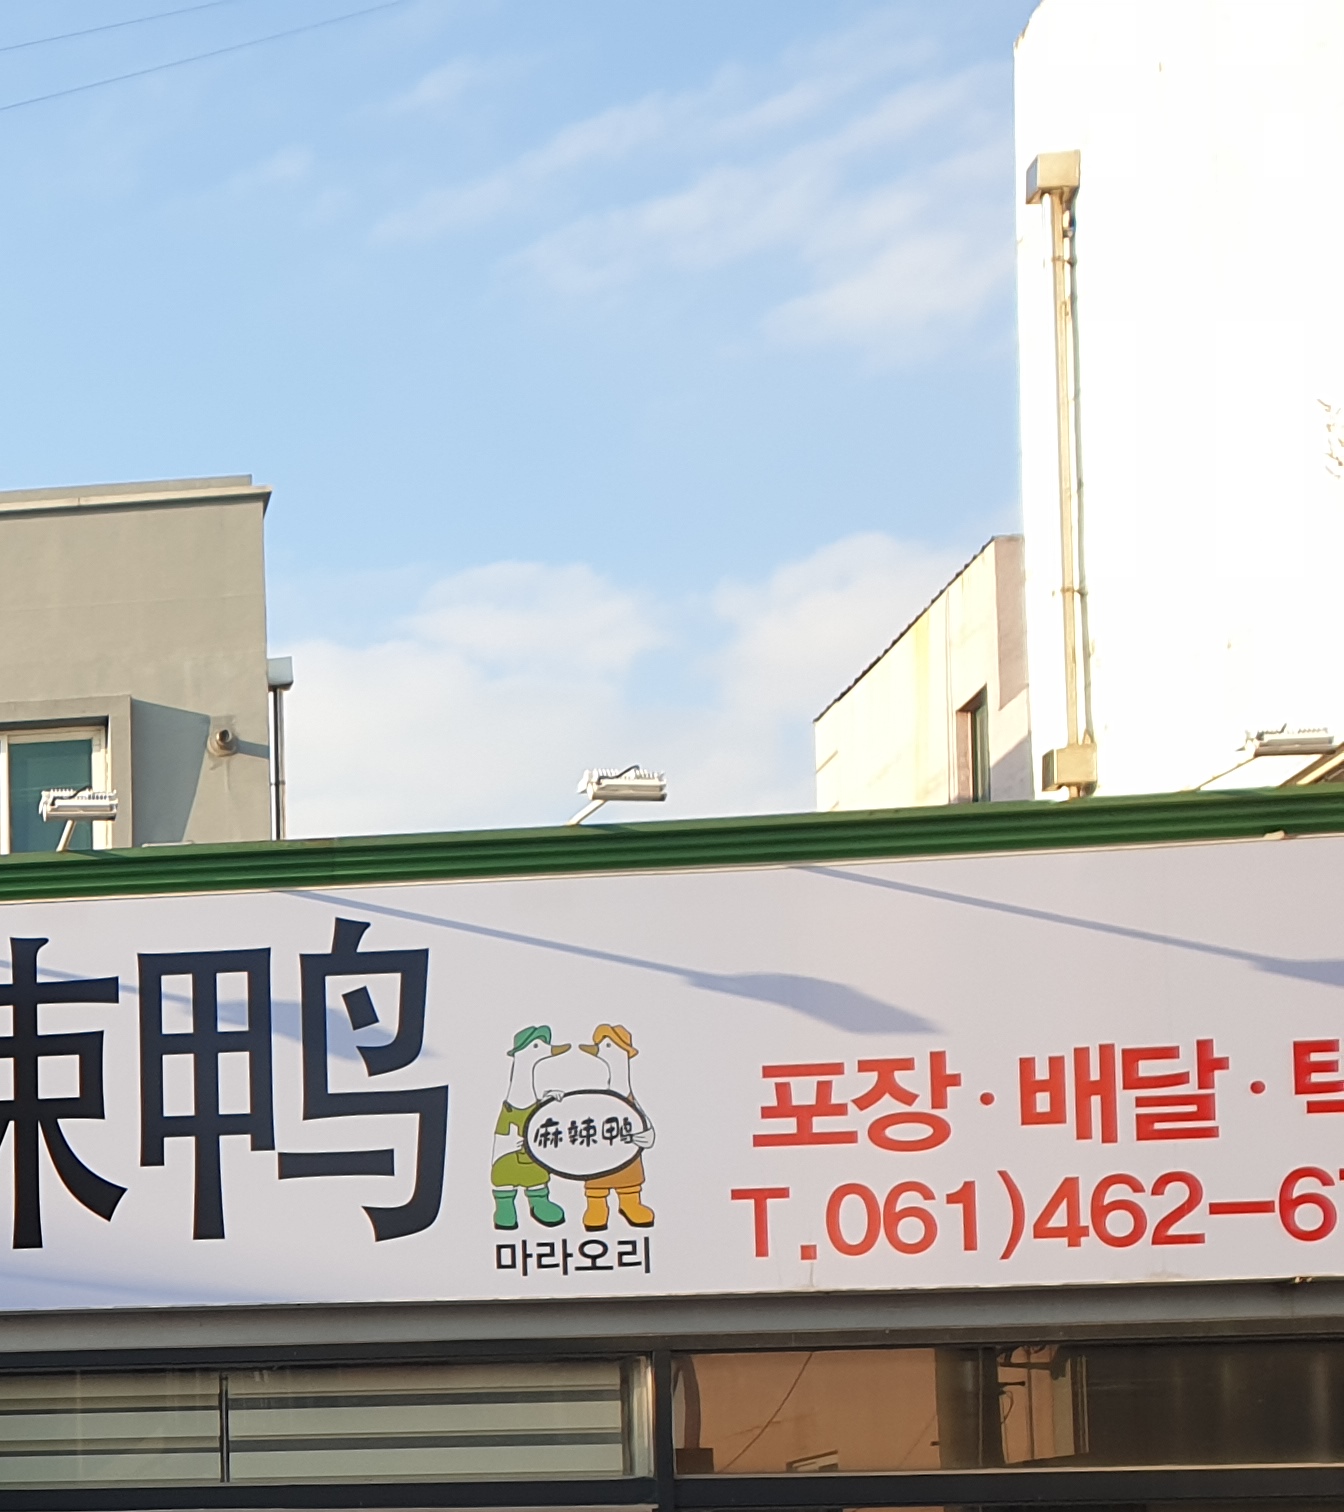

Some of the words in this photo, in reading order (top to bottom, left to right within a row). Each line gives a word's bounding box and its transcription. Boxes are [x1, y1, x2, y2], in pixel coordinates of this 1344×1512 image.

[533, 1116, 635, 1149] 麻辣鸭
[730, 1166, 1344, 1261] T.061)462-6
[495, 1236, 651, 1276] 마라오리
